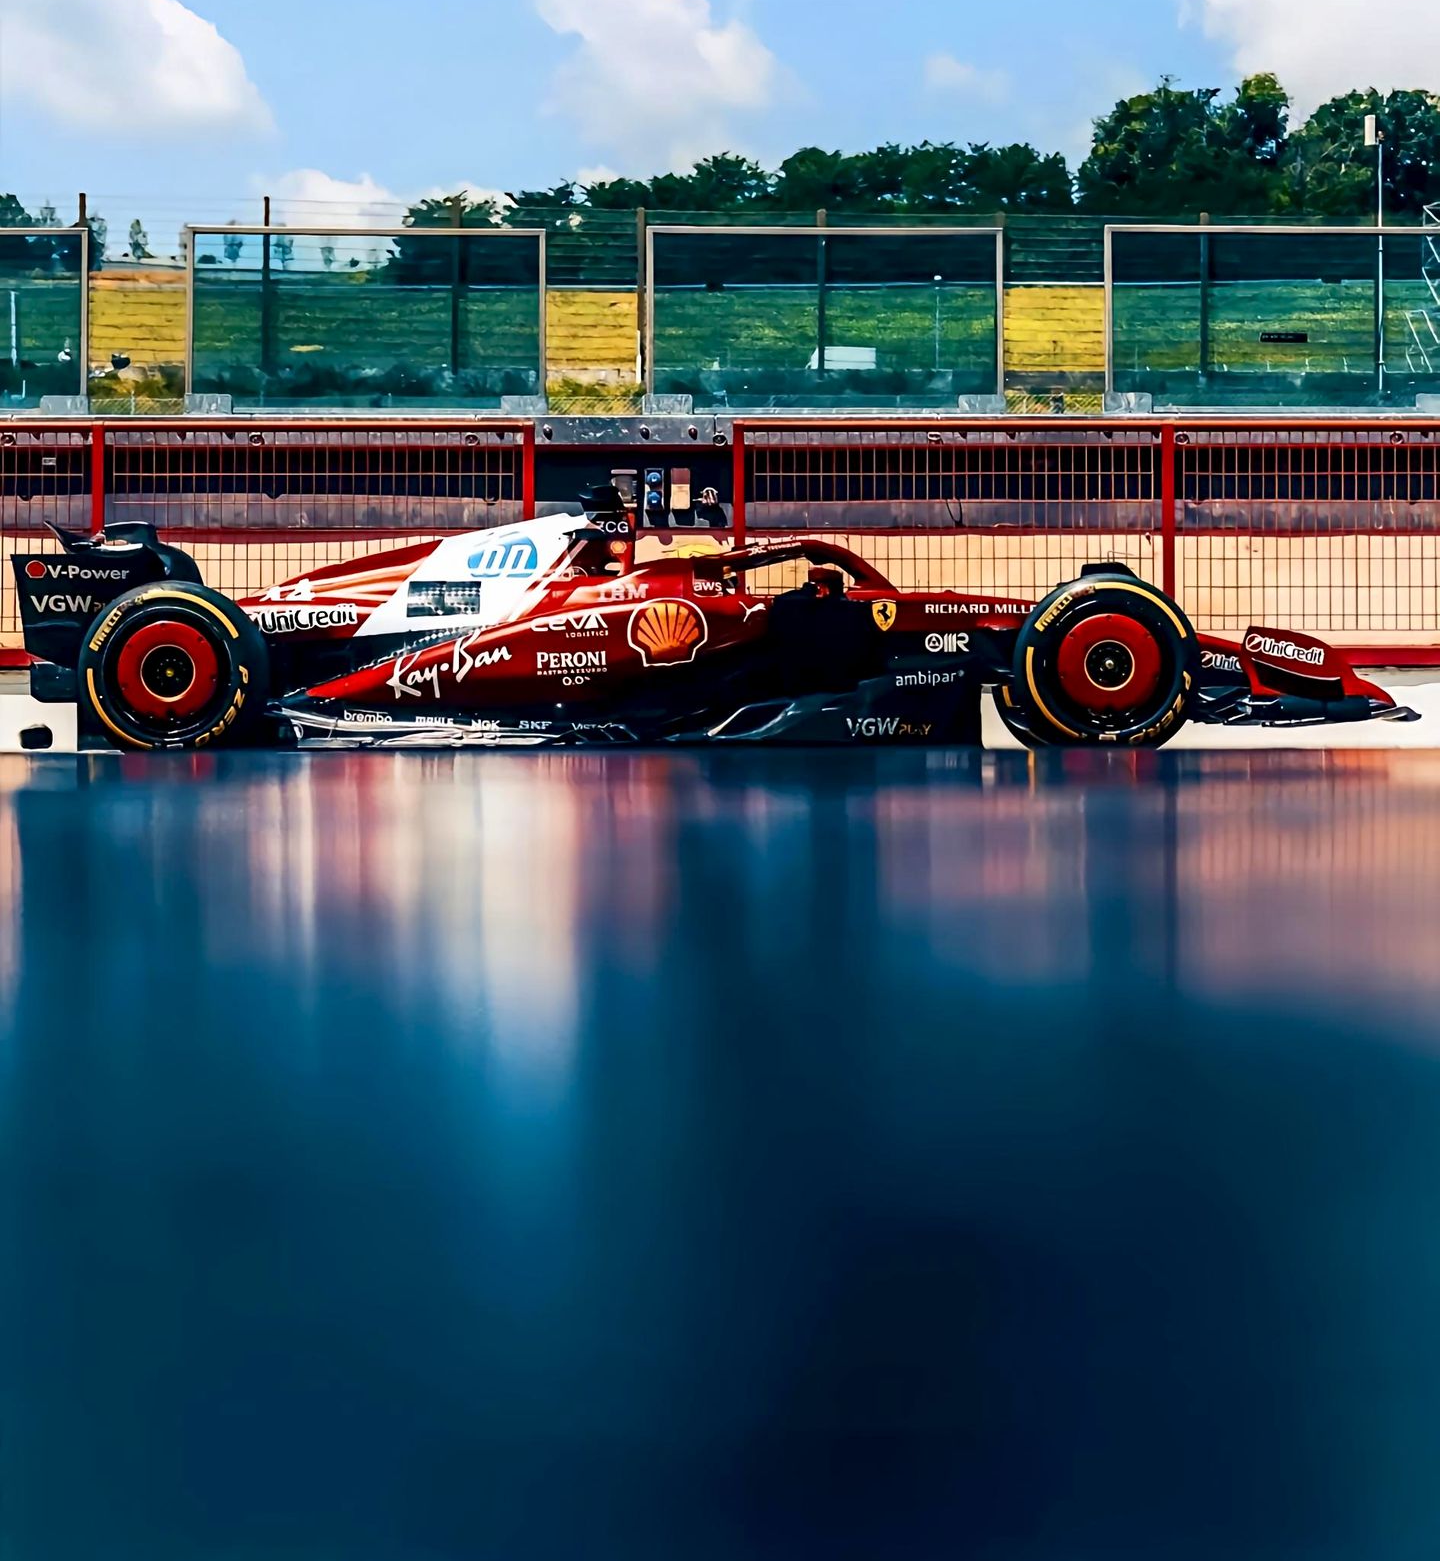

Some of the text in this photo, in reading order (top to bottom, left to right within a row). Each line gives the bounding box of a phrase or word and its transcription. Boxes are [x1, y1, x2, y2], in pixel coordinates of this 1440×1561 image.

[47, 564, 130, 579] V-Power
[598, 583, 649, 602] IBM
[693, 581, 723, 592] aws
[925, 604, 989, 614] RICHARD
[261, 603, 357, 633] UniCredit
[1262, 638, 1324, 665] UniCredit
[536, 650, 607, 669] PERONI
[895, 670, 957, 687] ambipar
[343, 709, 393, 723] brembo
[471, 719, 501, 731] NGK
[518, 720, 552, 730] SKF
